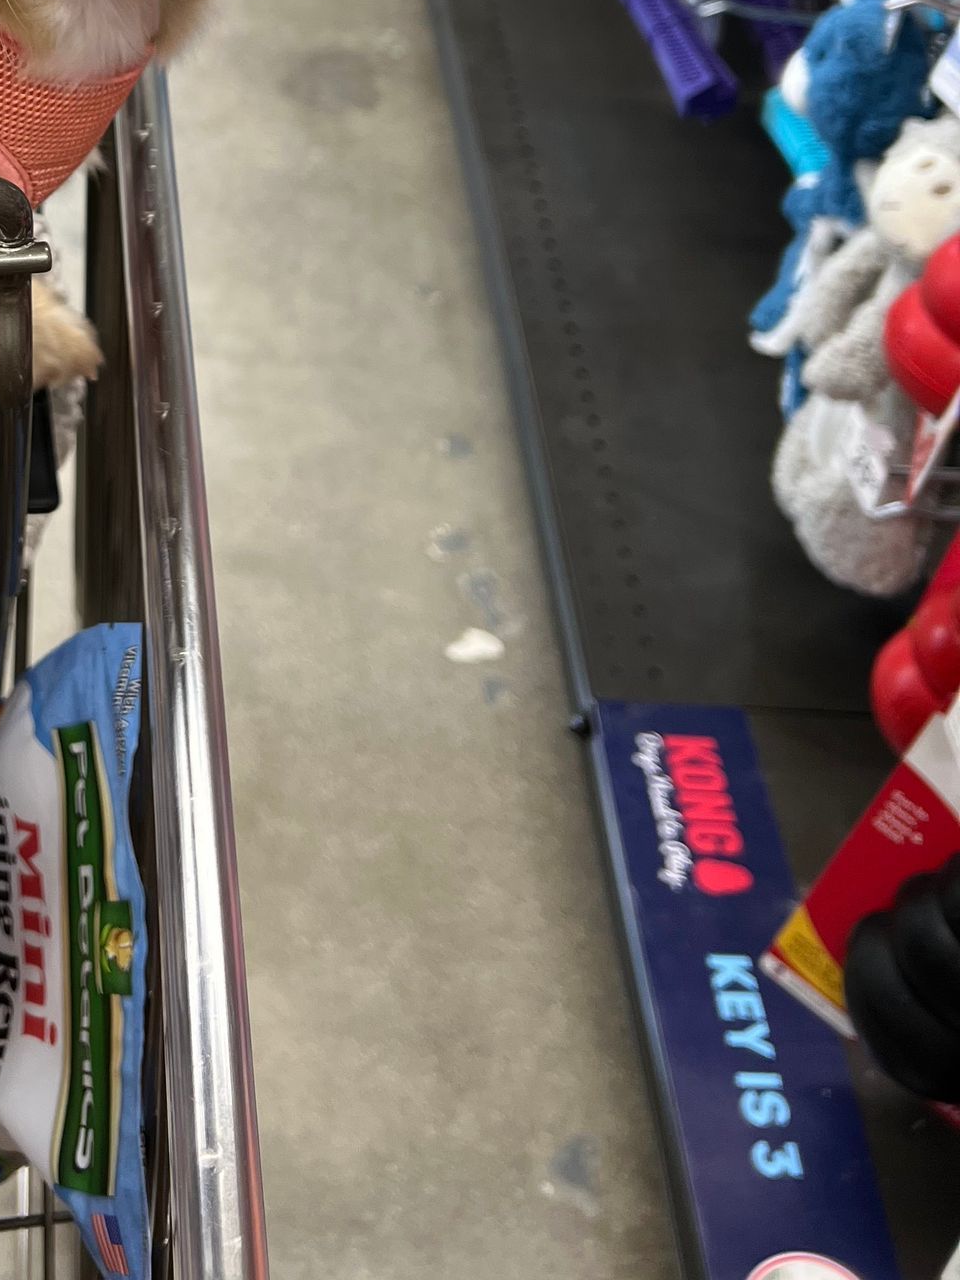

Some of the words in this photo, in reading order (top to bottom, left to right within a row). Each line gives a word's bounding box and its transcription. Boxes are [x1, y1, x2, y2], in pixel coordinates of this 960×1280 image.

[68, 740, 88, 848] Pet
[661, 732, 745, 858] KONG
[14, 813, 59, 1048] Mini
[72, 863, 96, 1173] Botanics
[704, 951, 777, 1062] KEY
[733, 1070, 793, 1129] IS
[750, 1137, 806, 1181] 3
